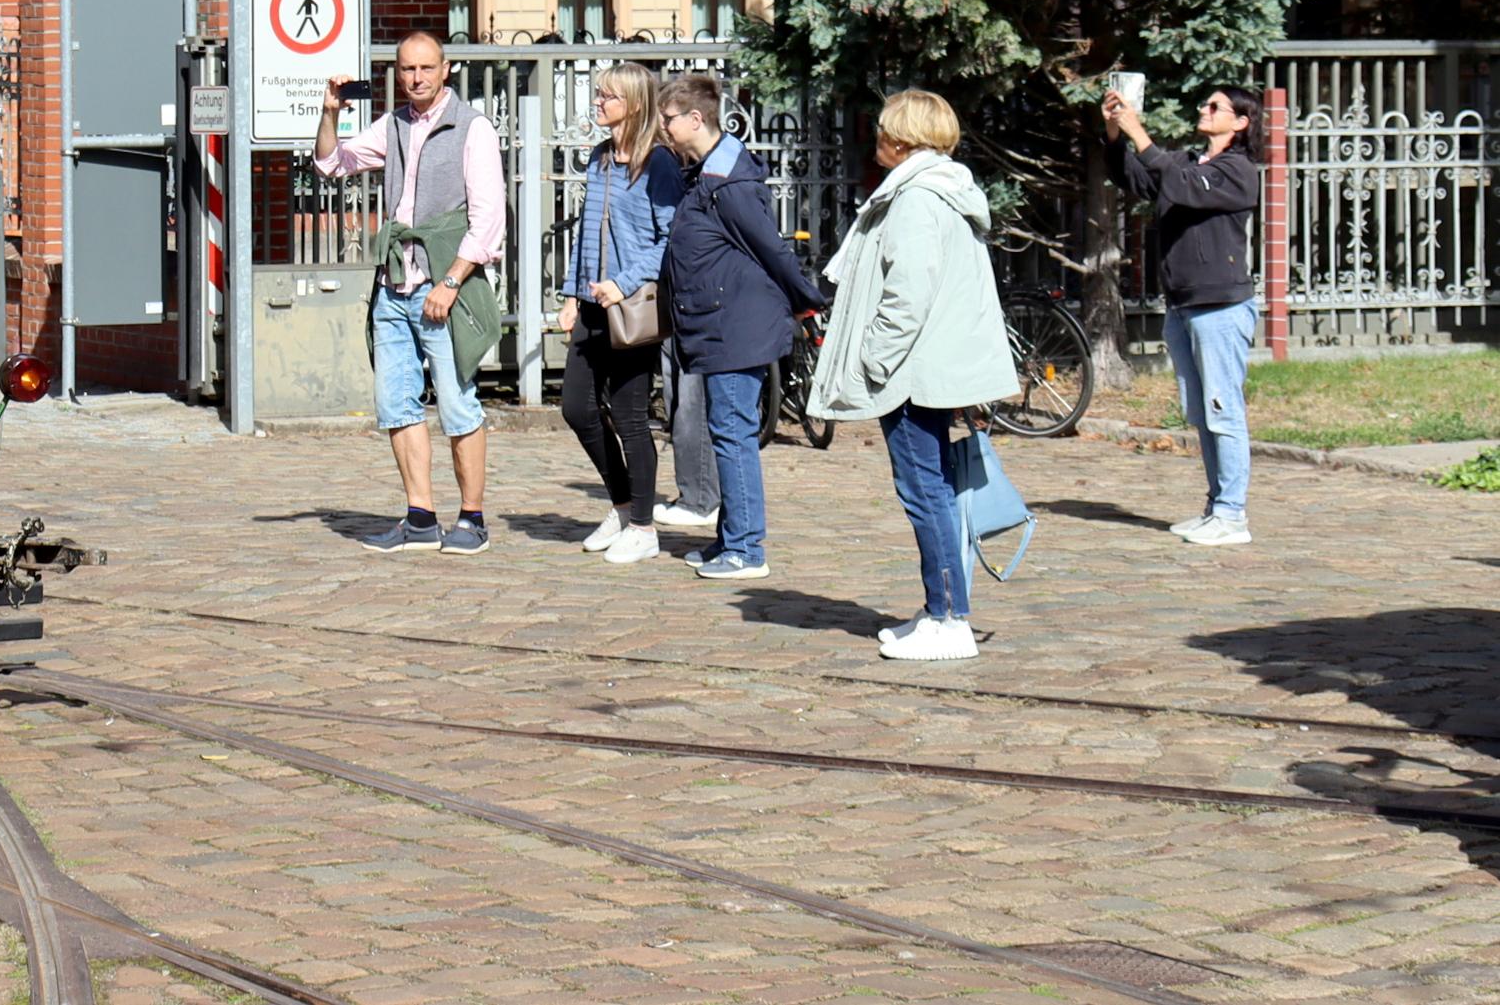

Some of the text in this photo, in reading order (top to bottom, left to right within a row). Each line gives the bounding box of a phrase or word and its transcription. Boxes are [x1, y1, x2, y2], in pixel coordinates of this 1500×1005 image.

[261, 76, 330, 87] Fußgängeraus
[285, 88, 324, 97] benutze
[193, 92, 226, 111] Achtung!
[289, 103, 319, 116] 15m
